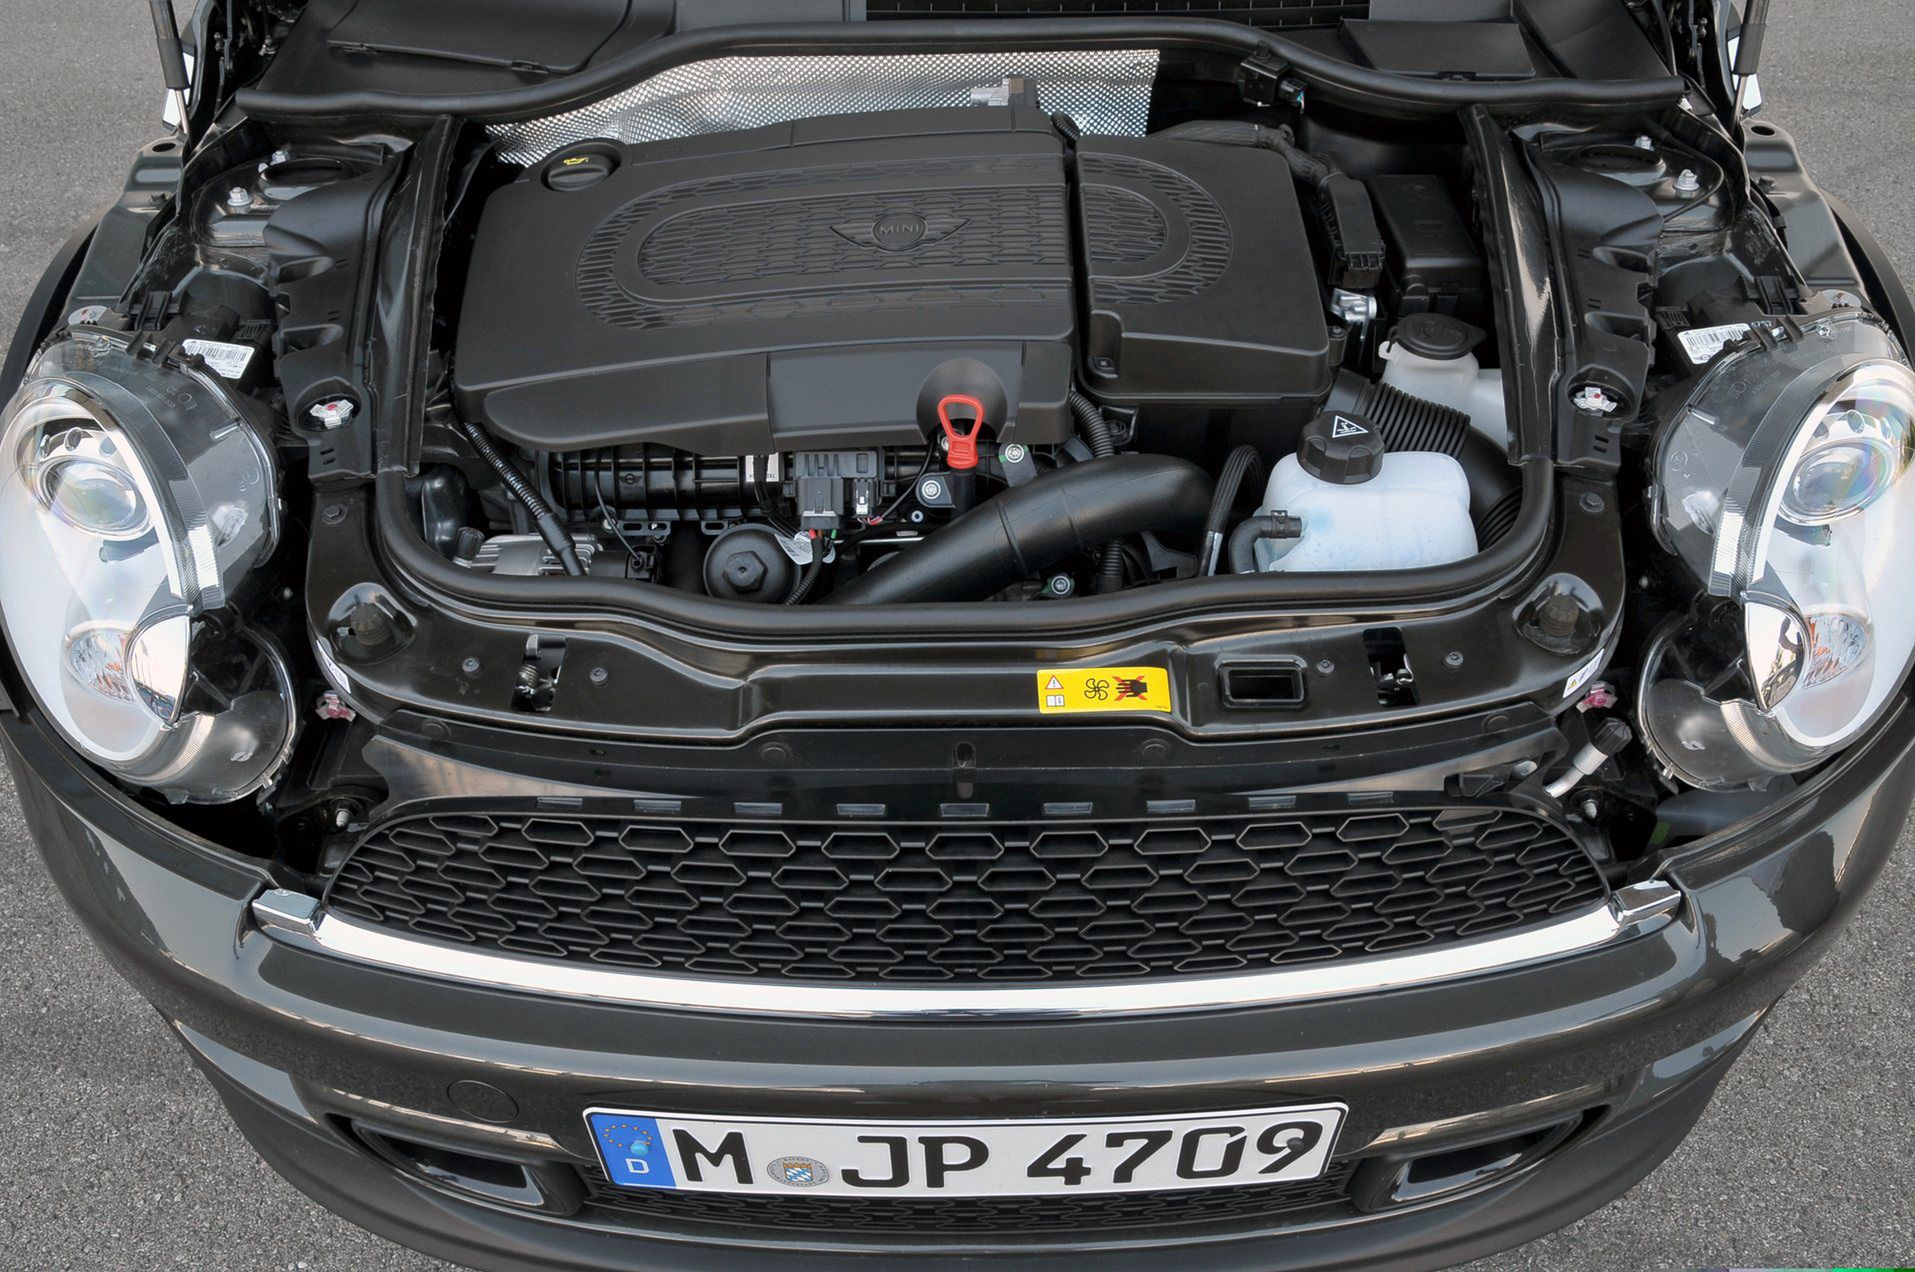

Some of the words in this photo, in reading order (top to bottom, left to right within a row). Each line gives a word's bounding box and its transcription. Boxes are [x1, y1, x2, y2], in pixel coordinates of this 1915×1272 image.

[879, 223, 920, 235] MINI
[672, 1128, 754, 1185] M
[841, 1135, 990, 1188] JP
[1026, 1120, 1324, 1186] 4709
[624, 1158, 650, 1174] D
